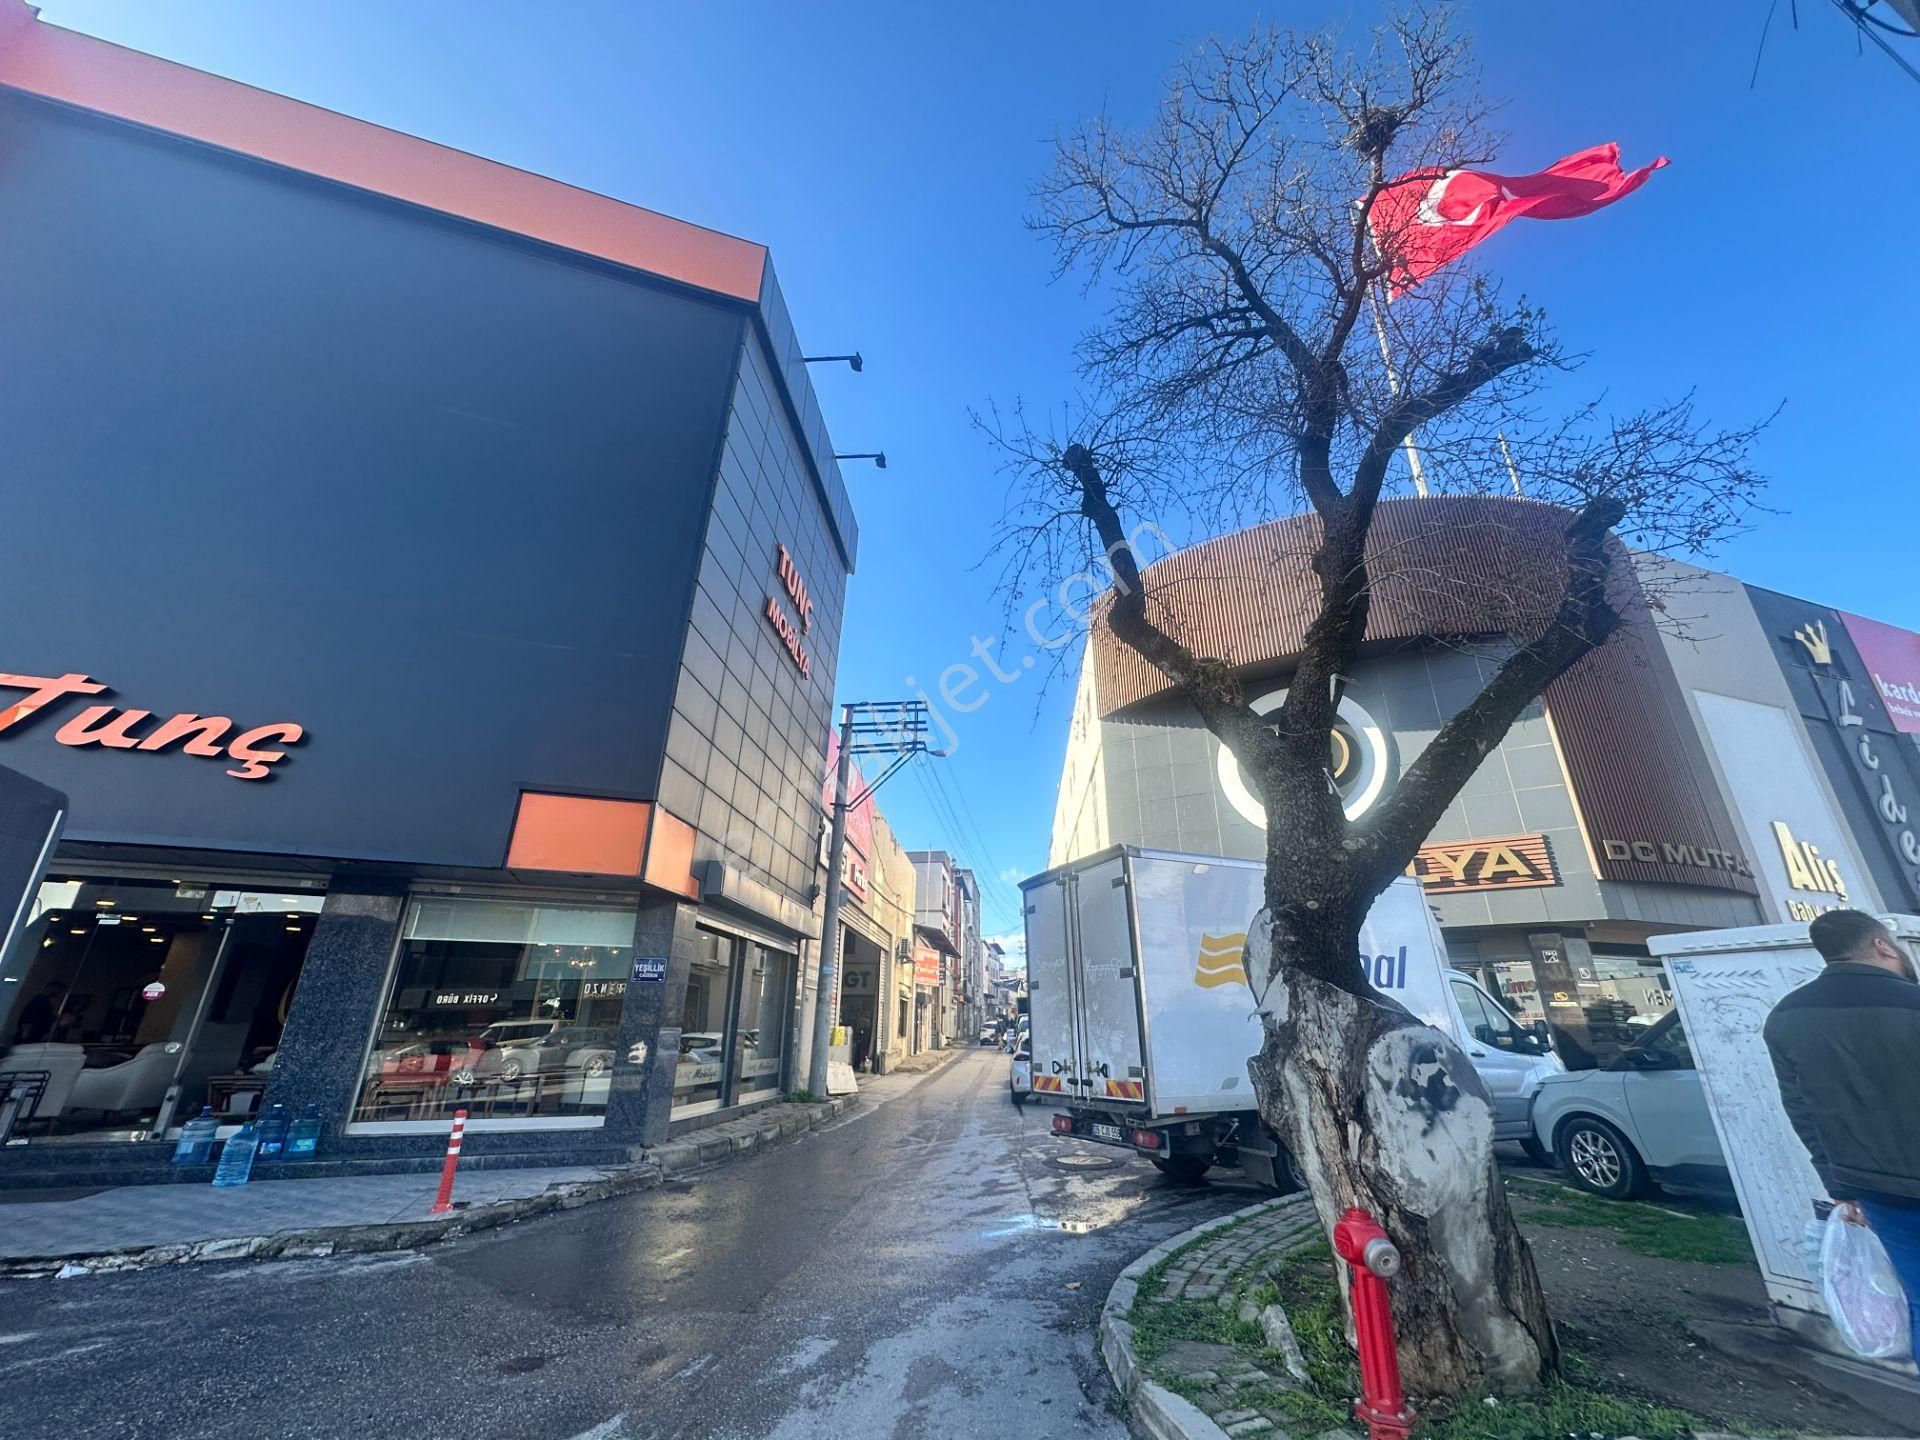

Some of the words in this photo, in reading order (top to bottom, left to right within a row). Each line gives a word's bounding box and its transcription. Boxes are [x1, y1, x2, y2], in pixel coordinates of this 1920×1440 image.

[779, 543, 813, 636] TUNÇ
[766, 596, 810, 681] MOBİLYA
[0, 673, 303, 779] Tunç
[1874, 673, 1920, 704] kard
[1603, 839, 1658, 862] DC
[1770, 821, 1848, 901] Aliş
